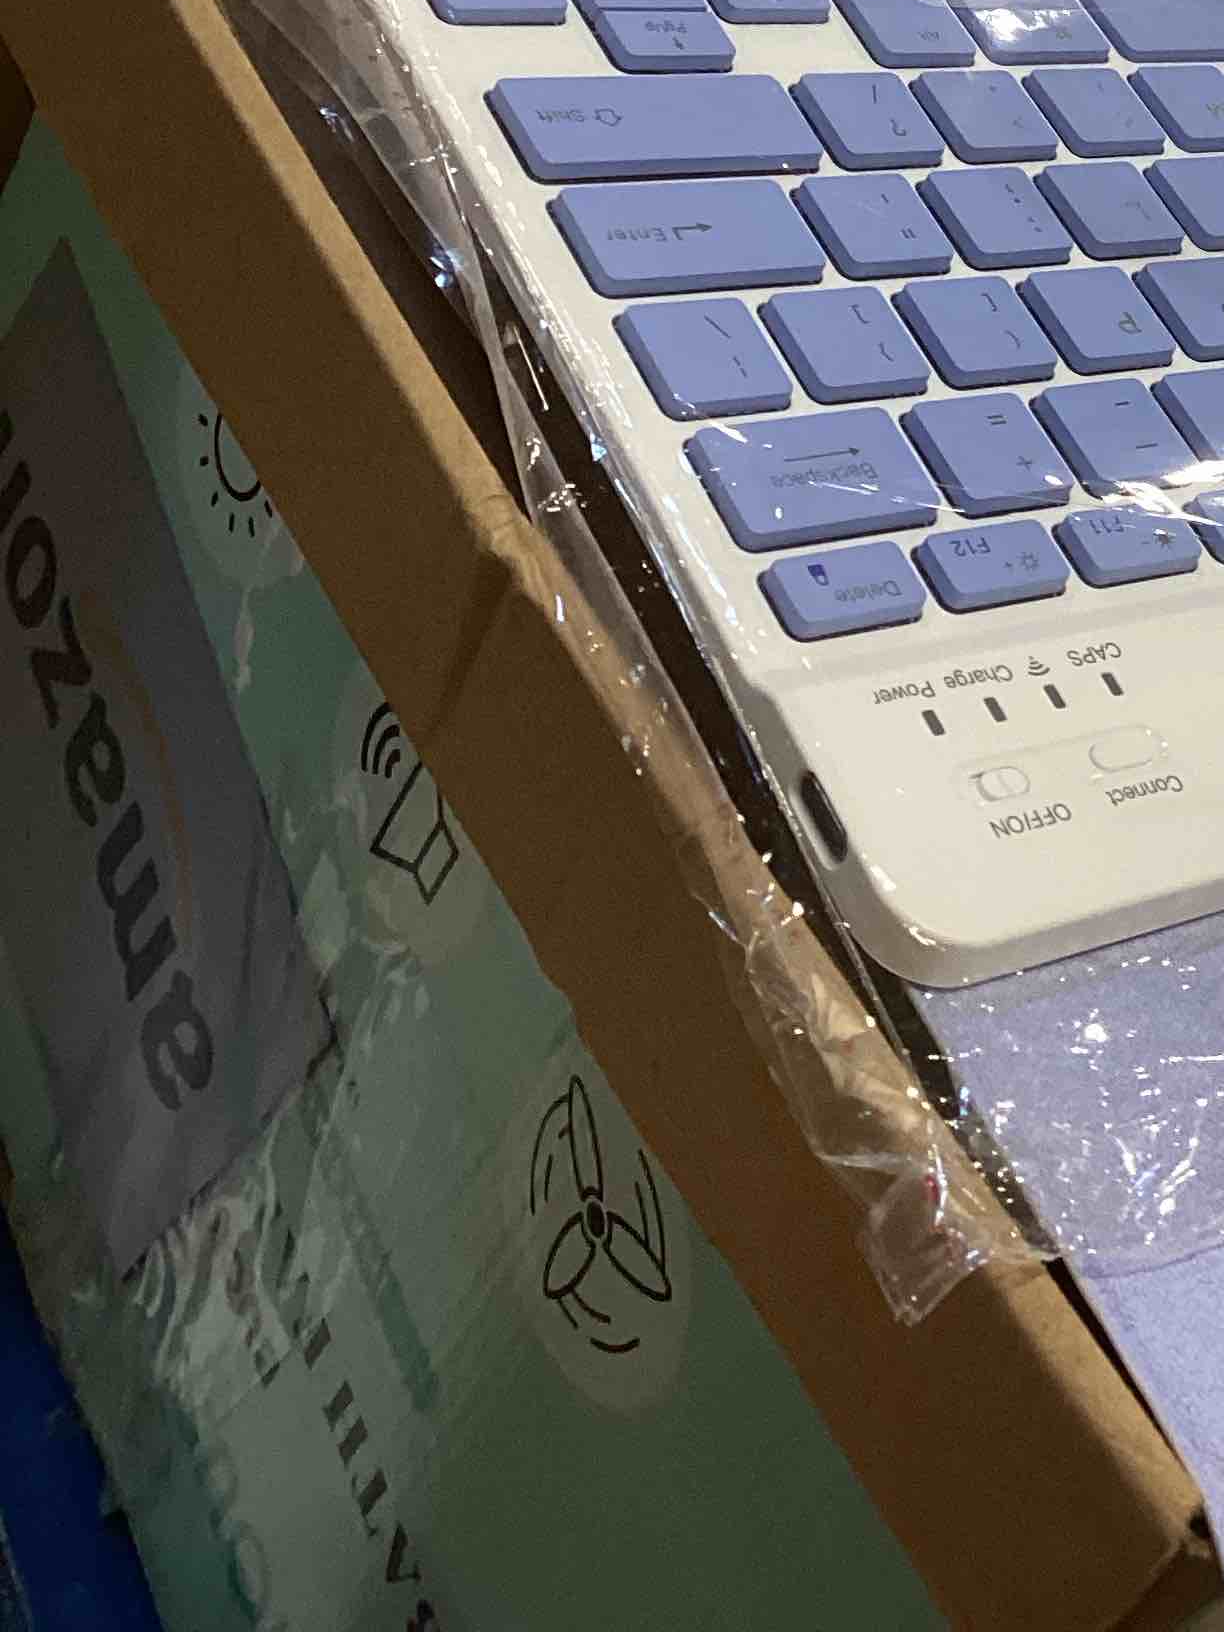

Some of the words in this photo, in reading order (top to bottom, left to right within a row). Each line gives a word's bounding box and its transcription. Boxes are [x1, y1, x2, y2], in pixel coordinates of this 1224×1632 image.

[534, 108, 587, 124] Shift
[605, 226, 667, 244] Enter
[949, 536, 992, 558] F12
[833, 579, 902, 604] Delete
[1065, 641, 1123, 667] CAPS
[942, 663, 1014, 692] Charge
[872, 679, 937, 707] Power
[1104, 774, 1184, 807] Connect
